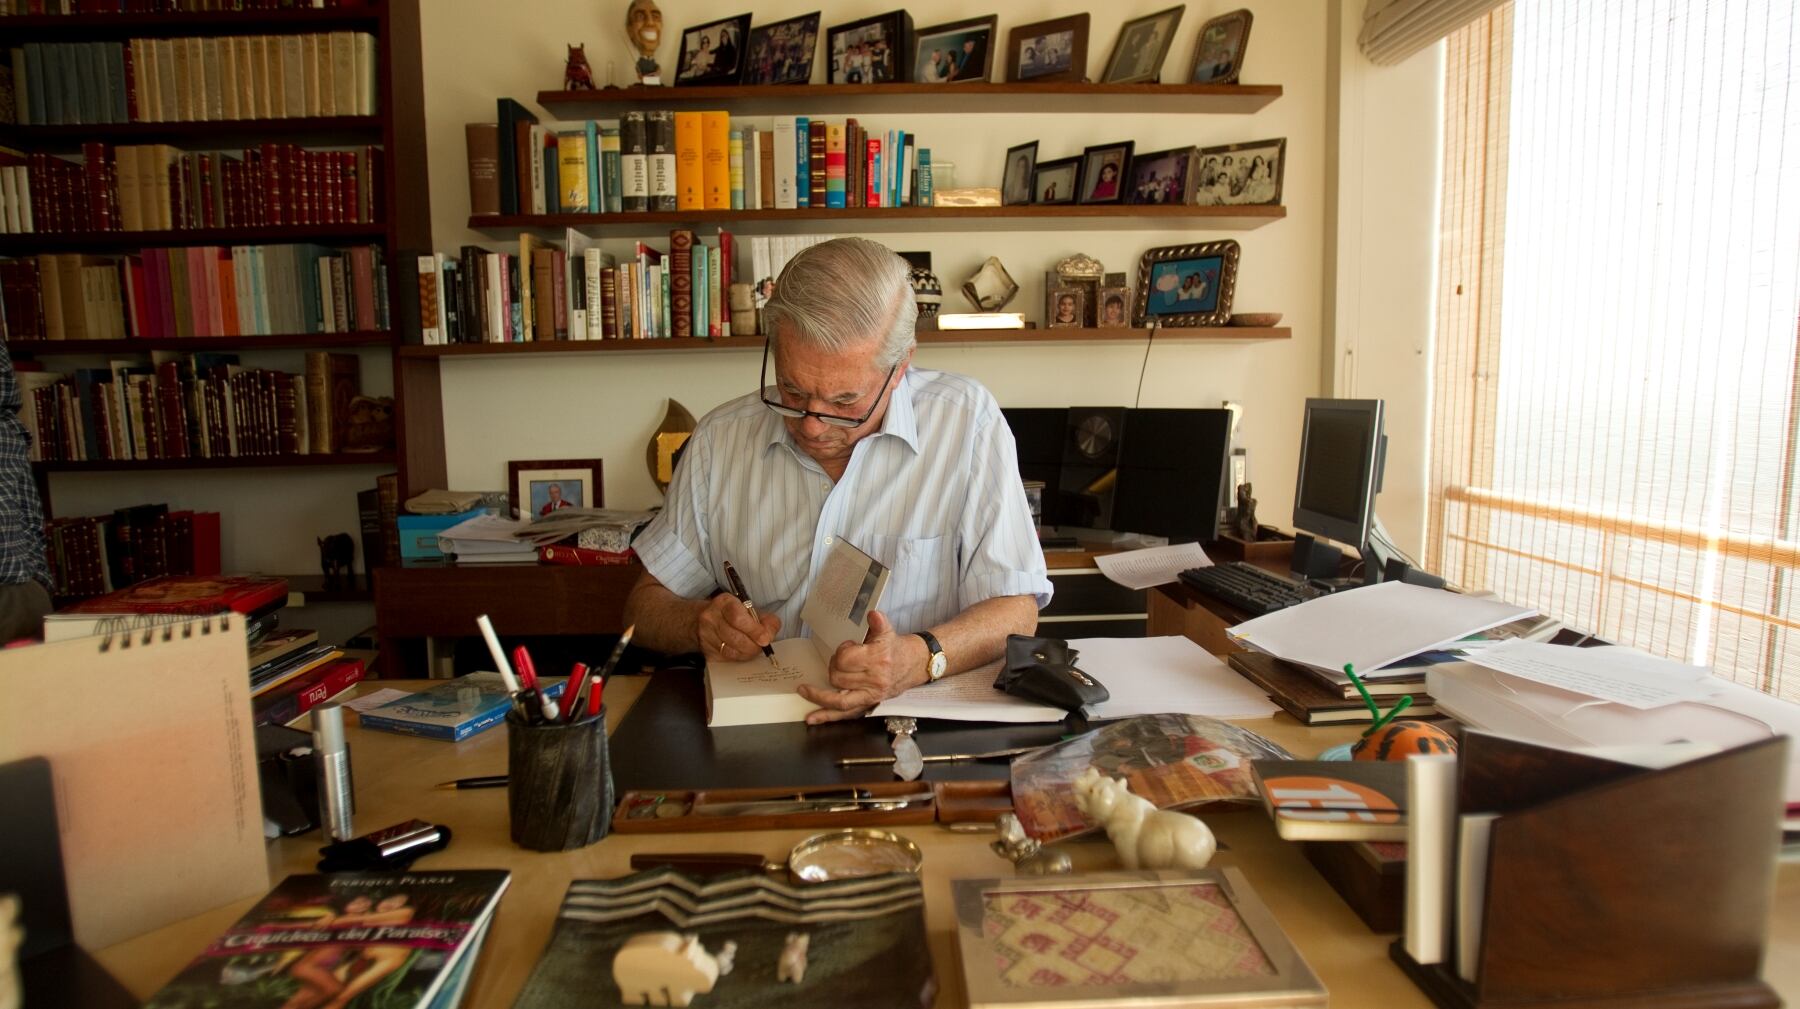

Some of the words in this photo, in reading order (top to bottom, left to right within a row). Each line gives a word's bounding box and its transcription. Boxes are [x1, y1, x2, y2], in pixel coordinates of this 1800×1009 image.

[330, 878, 394, 887] ENRIQUE
[400, 876, 454, 885] PLANAS
[337, 927, 371, 942] del
